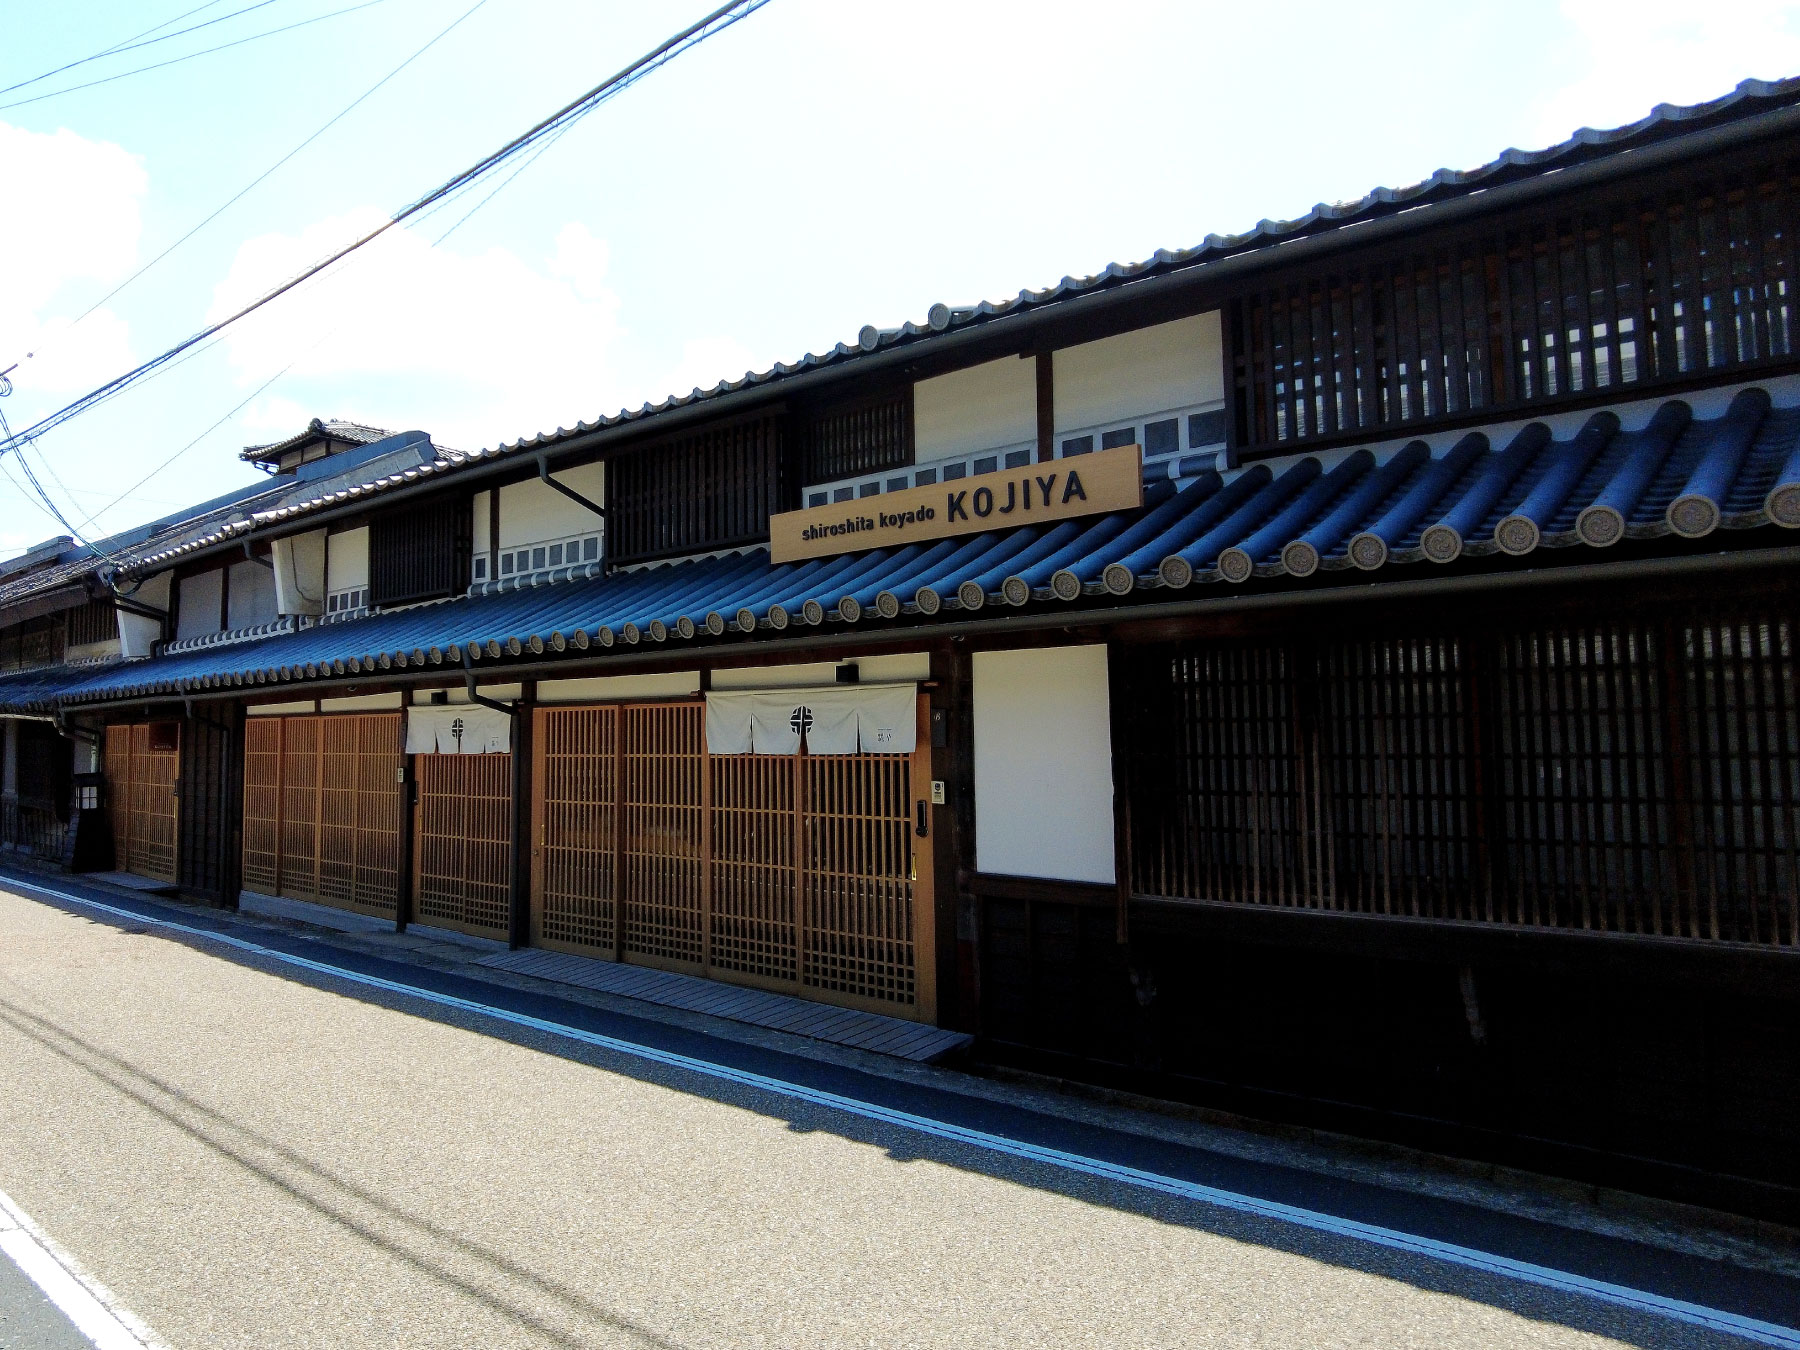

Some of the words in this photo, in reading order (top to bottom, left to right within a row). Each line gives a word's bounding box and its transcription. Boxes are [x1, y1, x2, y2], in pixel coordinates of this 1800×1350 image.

[801, 517, 875, 541] shiroshita
[879, 504, 935, 530] koyado
[946, 470, 1088, 523] KOJIYA
